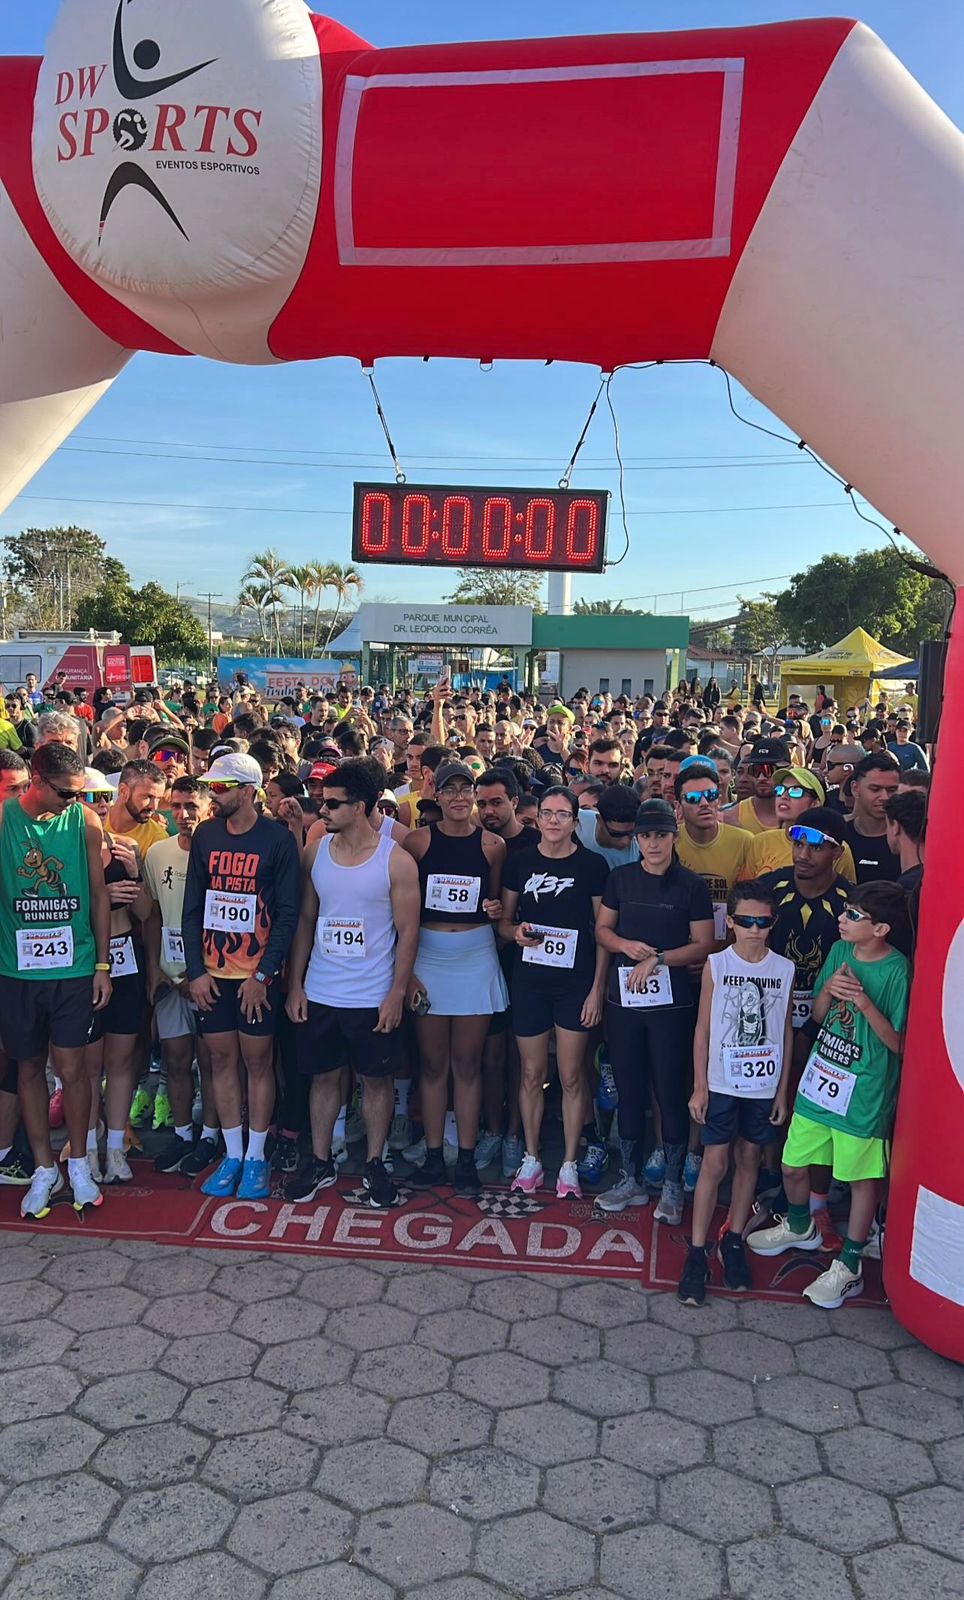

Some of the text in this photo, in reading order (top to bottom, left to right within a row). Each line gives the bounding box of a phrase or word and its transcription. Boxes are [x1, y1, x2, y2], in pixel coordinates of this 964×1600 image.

[55, 64, 107, 105] DW
[156, 160, 260, 175] EVENTOS ESPORTIVOS
[404, 613, 439, 622] PARQUE
[393, 625, 407, 633] DR.
[409, 625, 456, 634] LEOPOLDO
[268, 677, 305, 687] FESTA
[209, 851, 260, 877] FOGO
[225, 877, 256, 892] PISTA
[448, 889, 469, 902] 58
[15, 898, 78, 911] FORMIGA'S
[25, 911, 69, 920] RUNNERS
[220, 905, 250, 921] 190
[334, 931, 364, 945] 194
[33, 941, 68, 957] 243
[545, 940, 565, 956] 69
[723, 975, 781, 989] KEEP MOVING
[743, 1060, 775, 1078] 320
[818, 1076, 839, 1098] 79
[210, 1201, 645, 1263] CHEGADA
